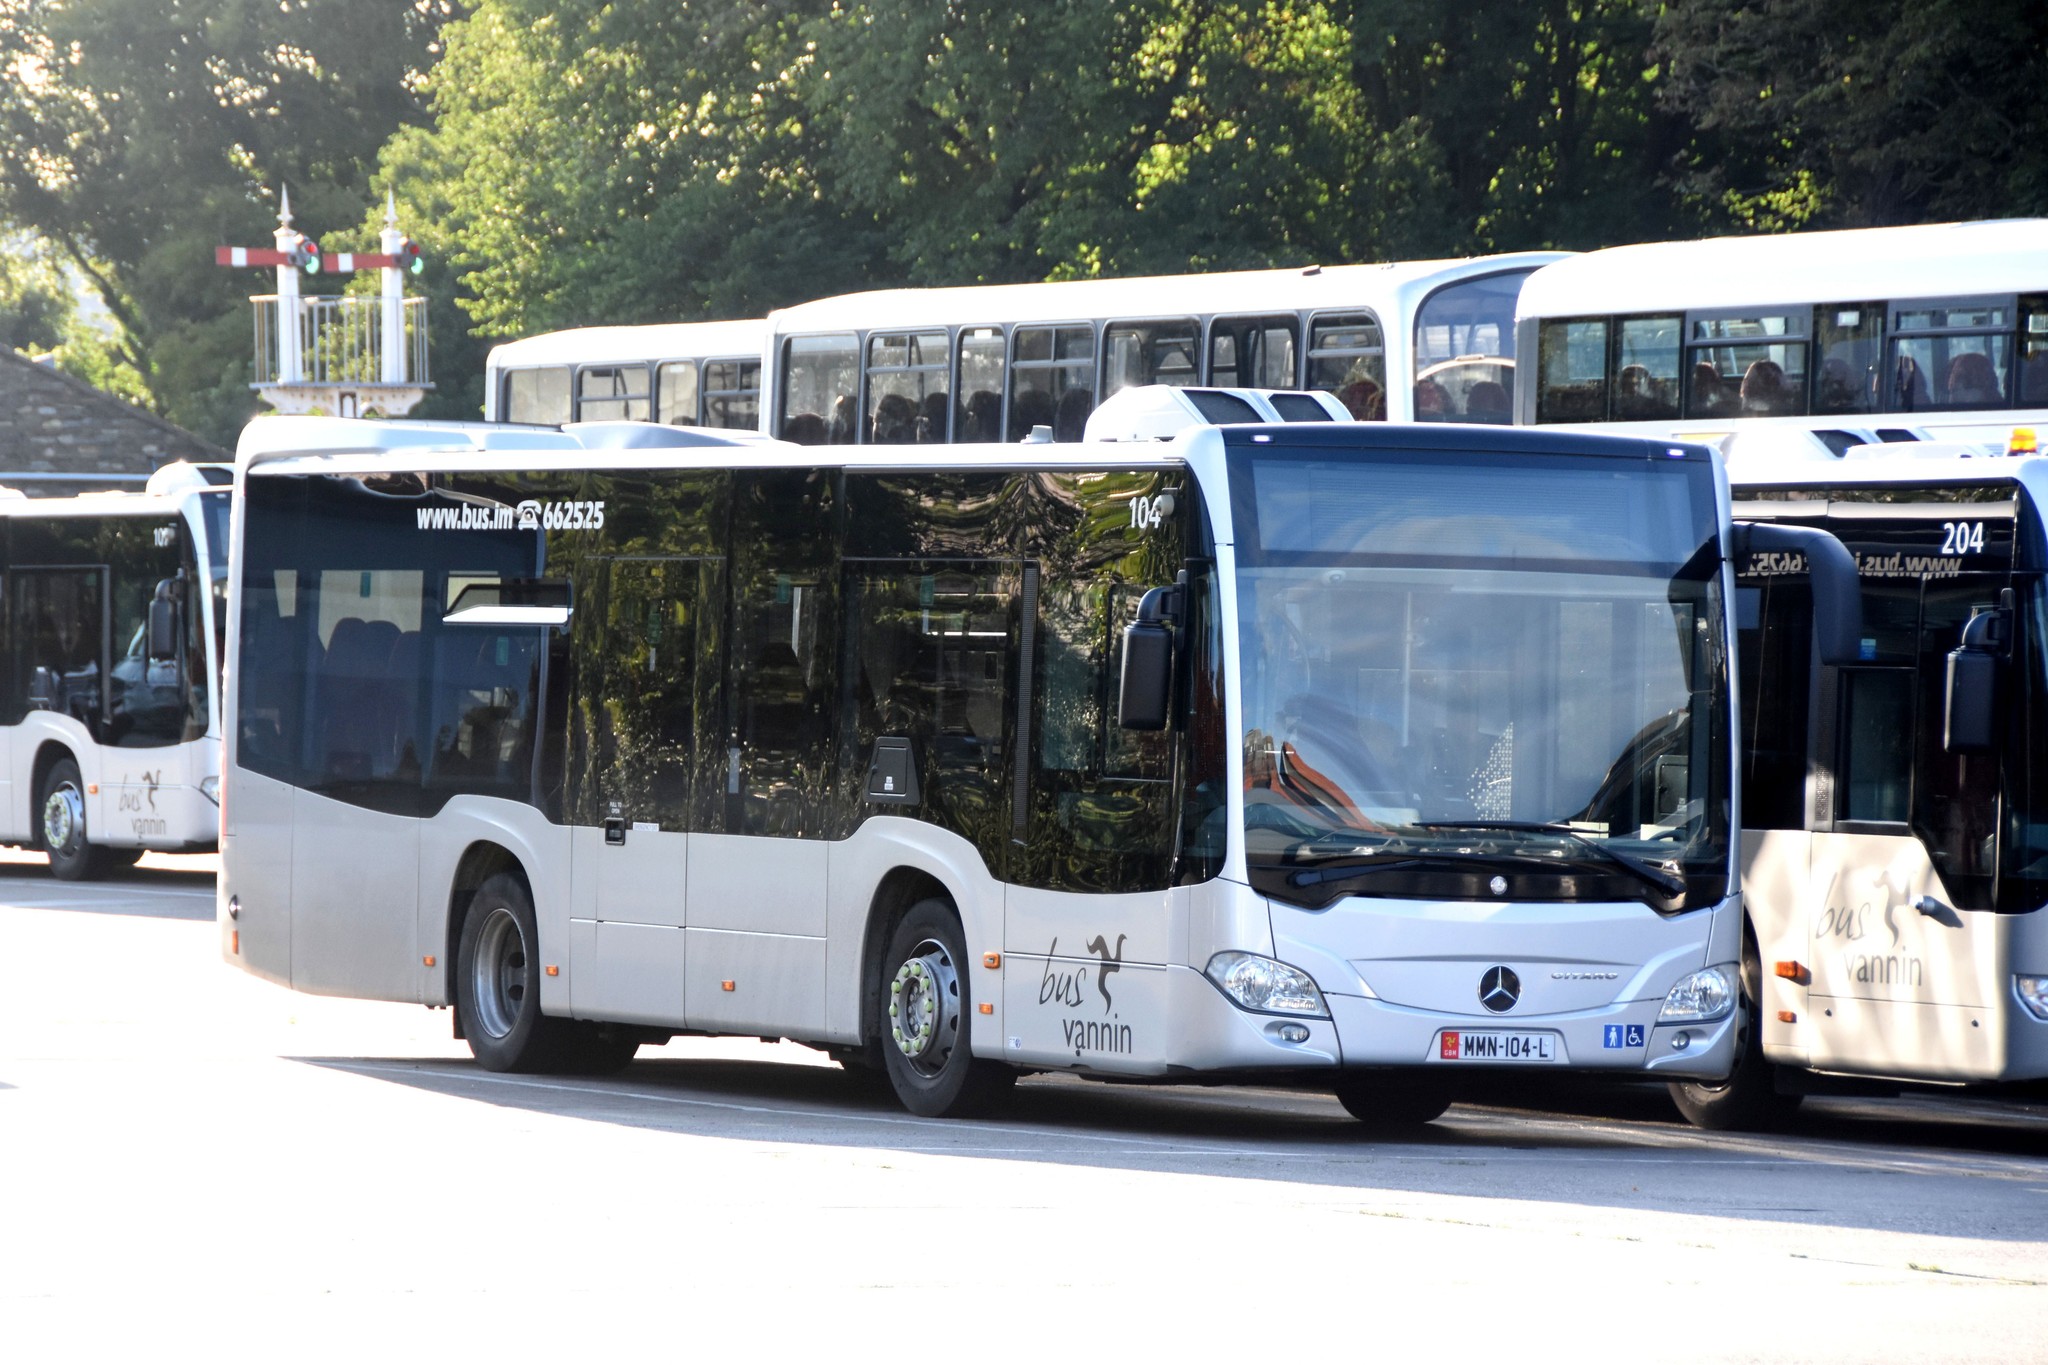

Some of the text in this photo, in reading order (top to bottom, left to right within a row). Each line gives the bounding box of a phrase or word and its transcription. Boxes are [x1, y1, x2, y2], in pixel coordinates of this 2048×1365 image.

[416, 501, 605, 530] www.bus.im 662525
[1129, 496, 1162, 529] 104
[1941, 521, 1985, 555] 204
[1815, 871, 1872, 941] bus
[1039, 936, 1087, 1008] bus
[1551, 972, 1619, 980] CITARO
[1843, 944, 1923, 987] vannin
[1062, 1012, 1132, 1054] vannin
